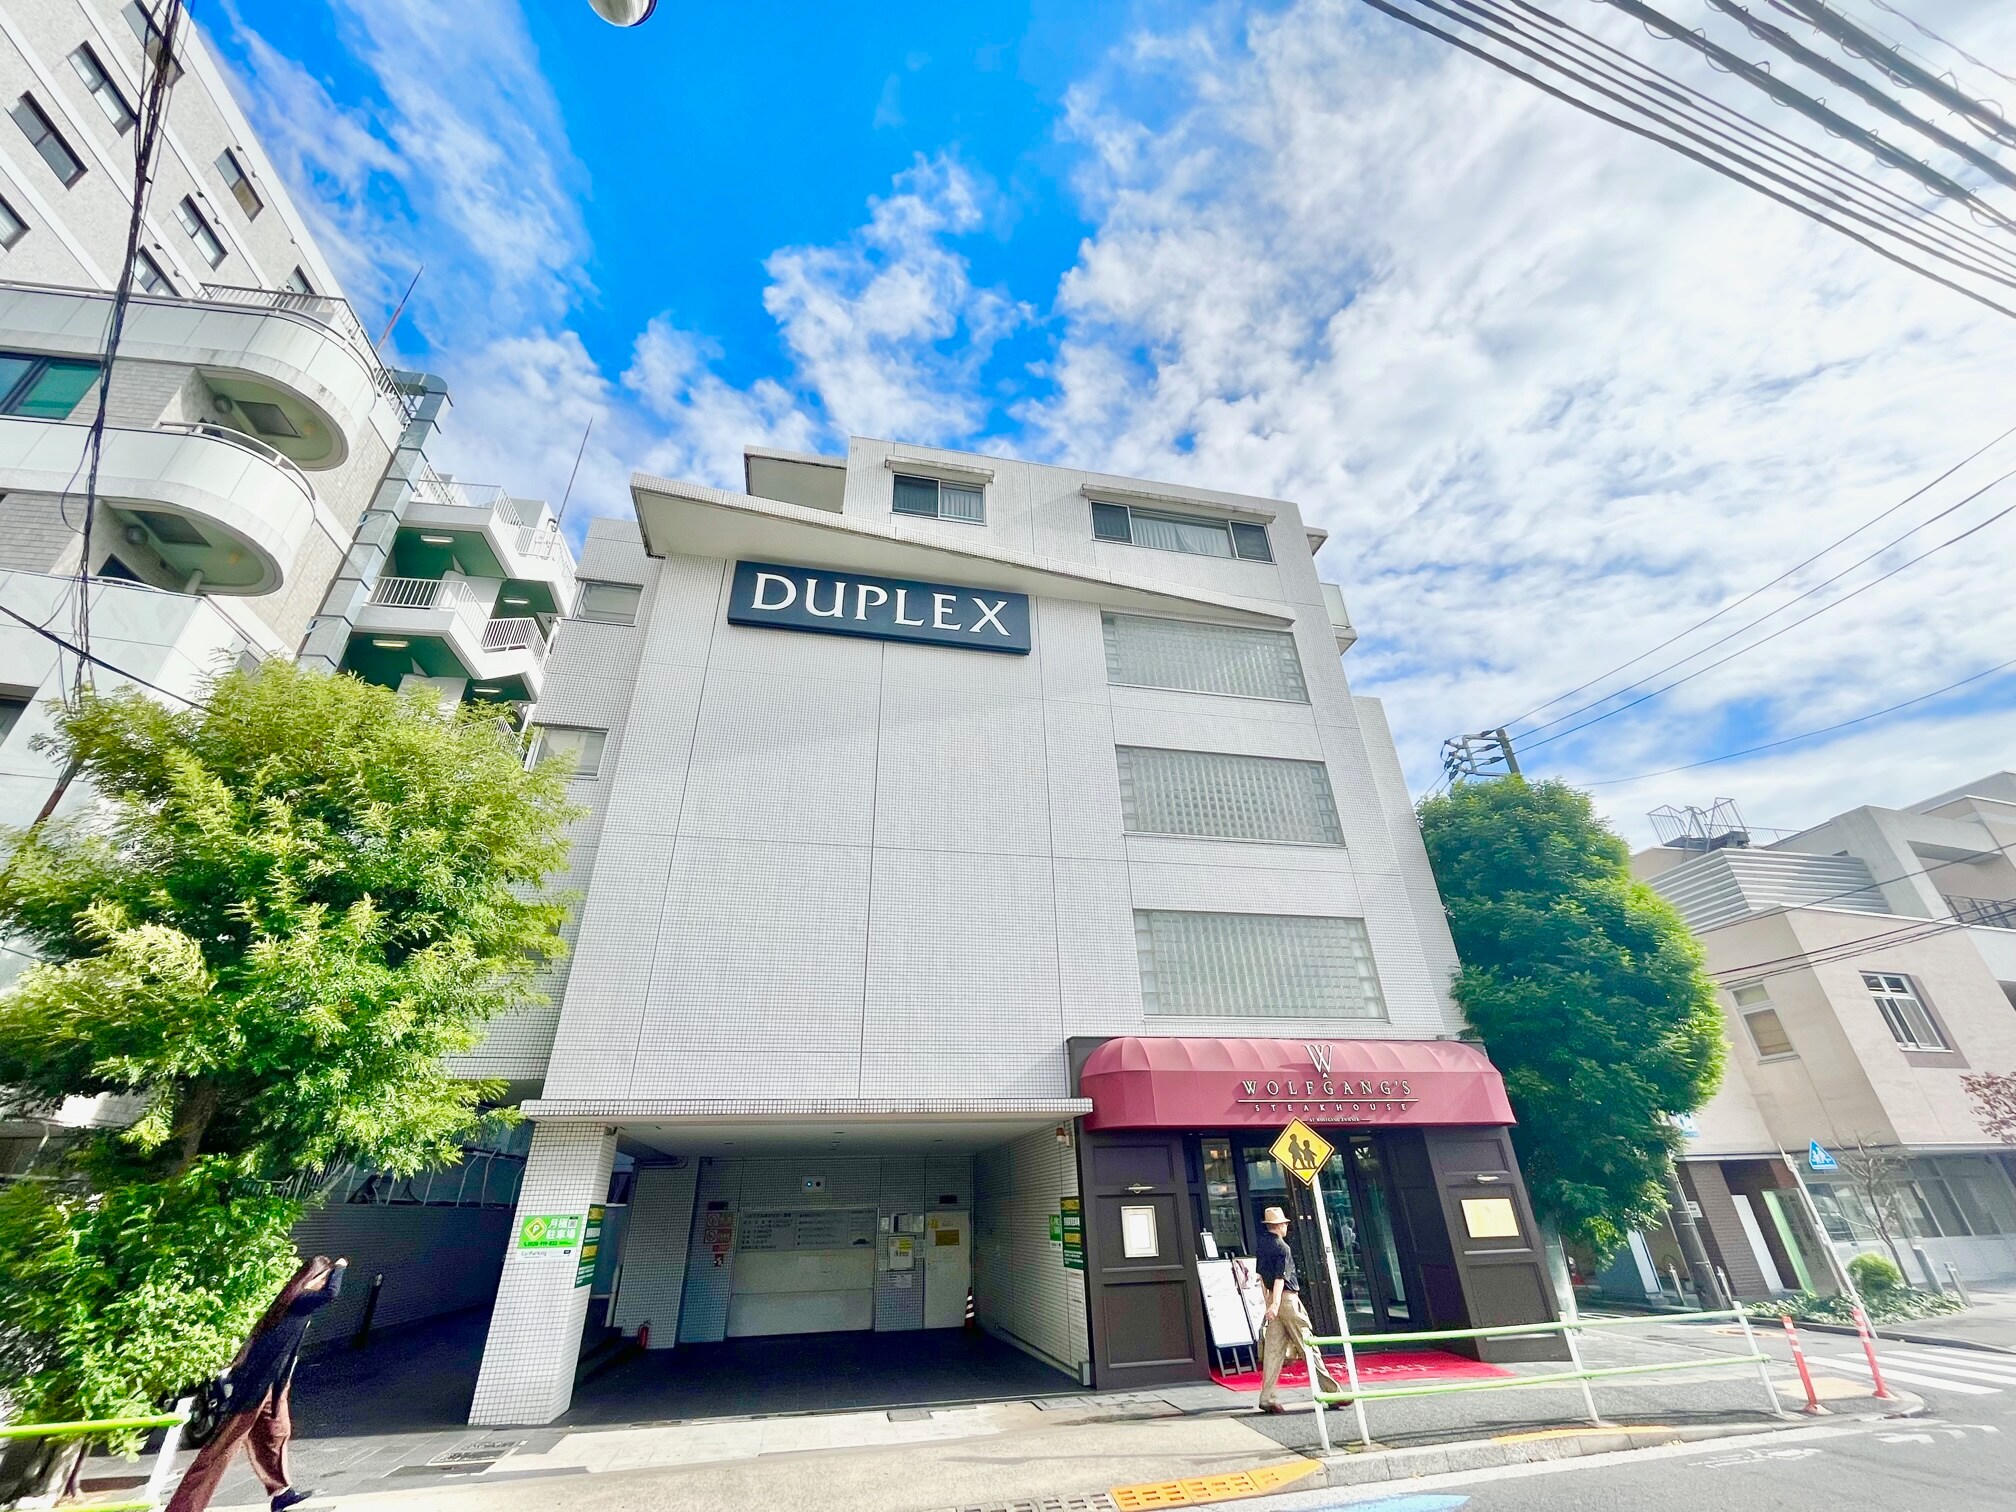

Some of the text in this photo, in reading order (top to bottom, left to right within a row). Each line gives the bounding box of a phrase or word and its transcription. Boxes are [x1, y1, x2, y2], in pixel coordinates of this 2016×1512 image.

[751, 572, 1012, 637] DUPLEX
[1302, 1044, 1335, 1073] W
[1242, 1080, 1412, 1096] WOLFGANG'S
[1254, 1103, 1407, 1112] STEAKHOUSE
